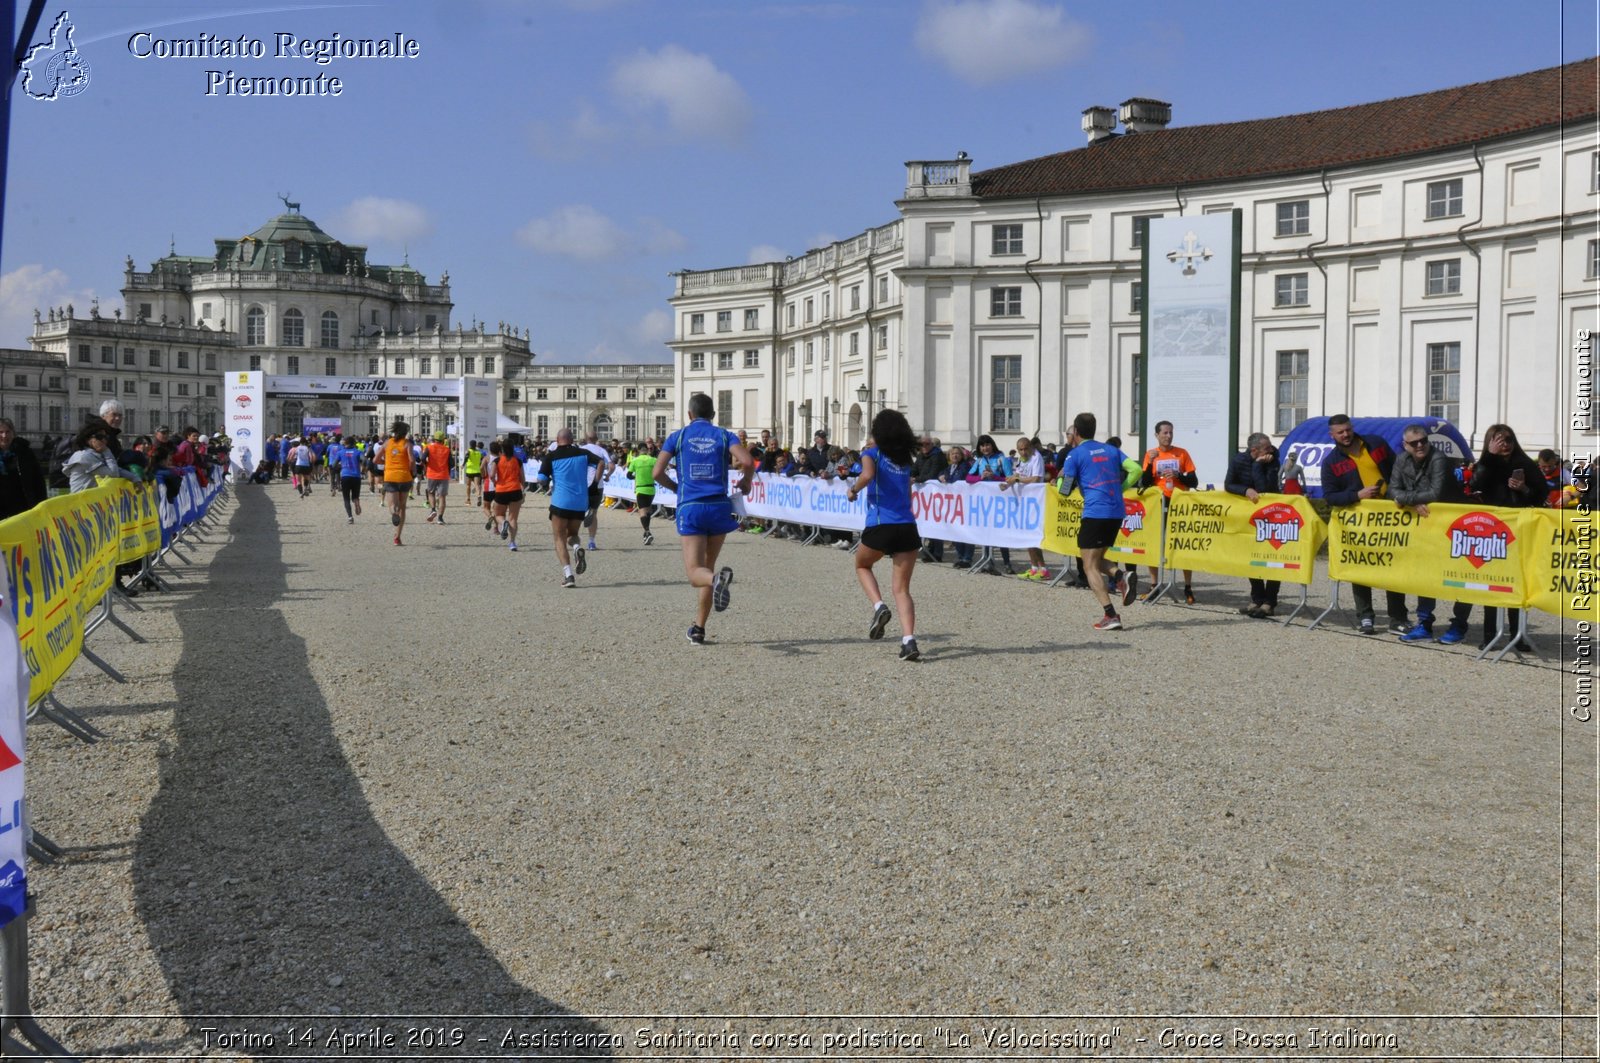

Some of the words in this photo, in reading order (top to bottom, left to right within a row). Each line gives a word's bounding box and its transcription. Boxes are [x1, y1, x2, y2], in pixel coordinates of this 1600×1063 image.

[1432, 441, 1453, 454] ma
[766, 482, 803, 509] HYBRID
[968, 495, 1041, 531] HYBRID
[1169, 505, 1189, 517] HAI
[1191, 504, 1223, 517] PRESO
[1338, 511, 1363, 526] HAI
[1366, 511, 1413, 527] PRESO
[1170, 520, 1225, 534] BIRAGHINI
[1254, 518, 1300, 544] Biraghi
[1341, 531, 1410, 547] BIRAGHINI
[1451, 529, 1508, 562] Biraghi
[1340, 549, 1394, 567] SNACK?
[1482, 574, 1516, 584] ITALIANO
[46, 609, 75, 658] mercato
